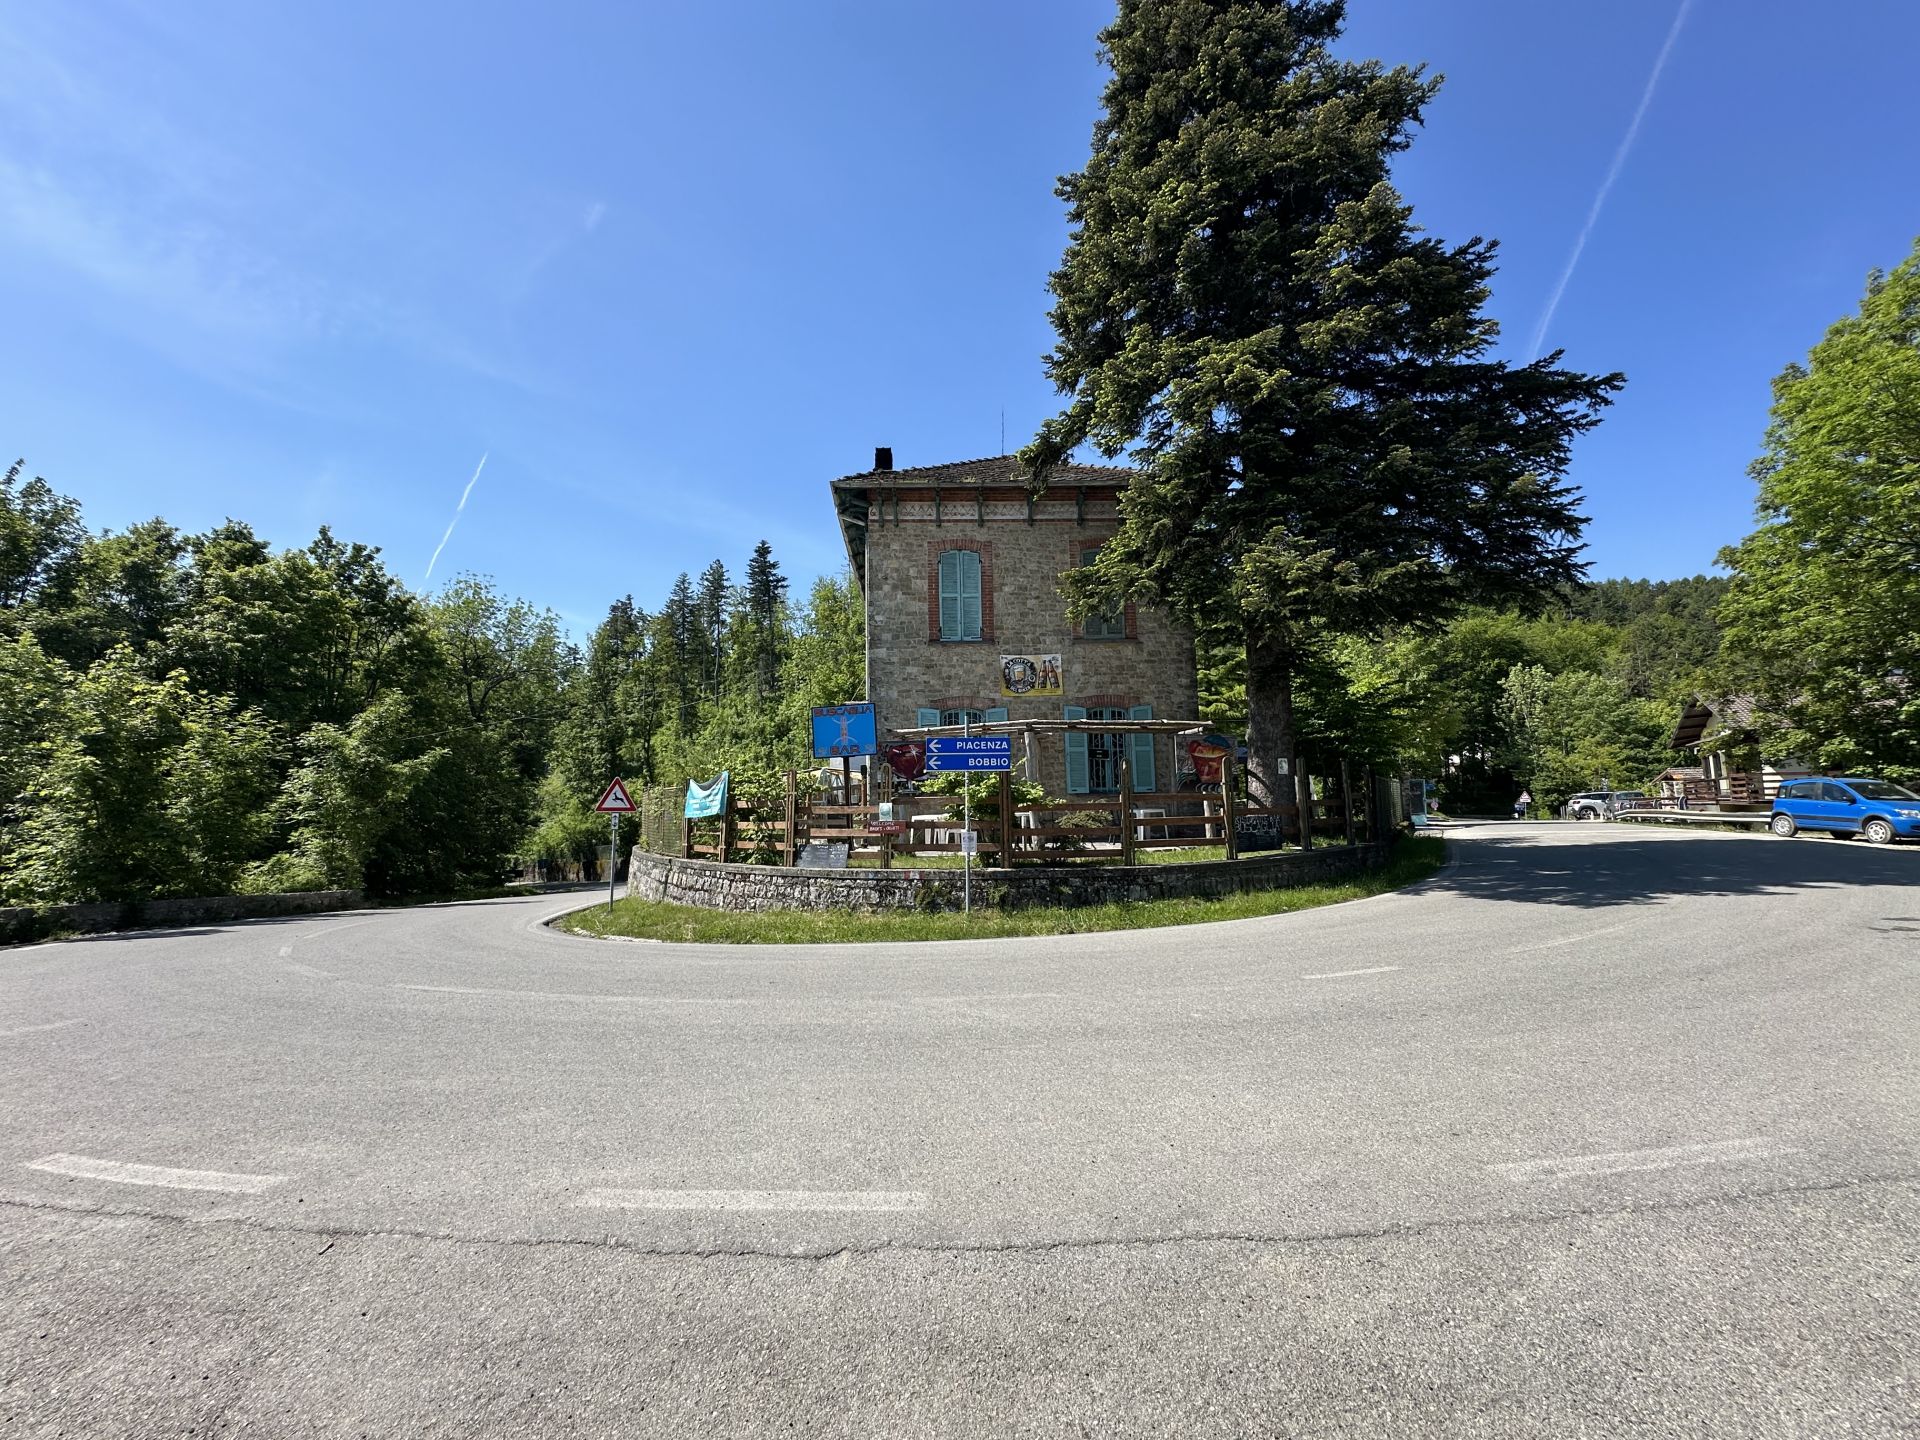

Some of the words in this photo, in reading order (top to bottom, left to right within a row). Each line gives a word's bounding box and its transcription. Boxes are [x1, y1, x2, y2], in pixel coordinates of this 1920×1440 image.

[813, 705, 873, 717] BUSCAGLIA
[830, 744, 860, 756] BAR
[956, 741, 1009, 750] PIACENZA
[968, 757, 1009, 766] BOBBIO
